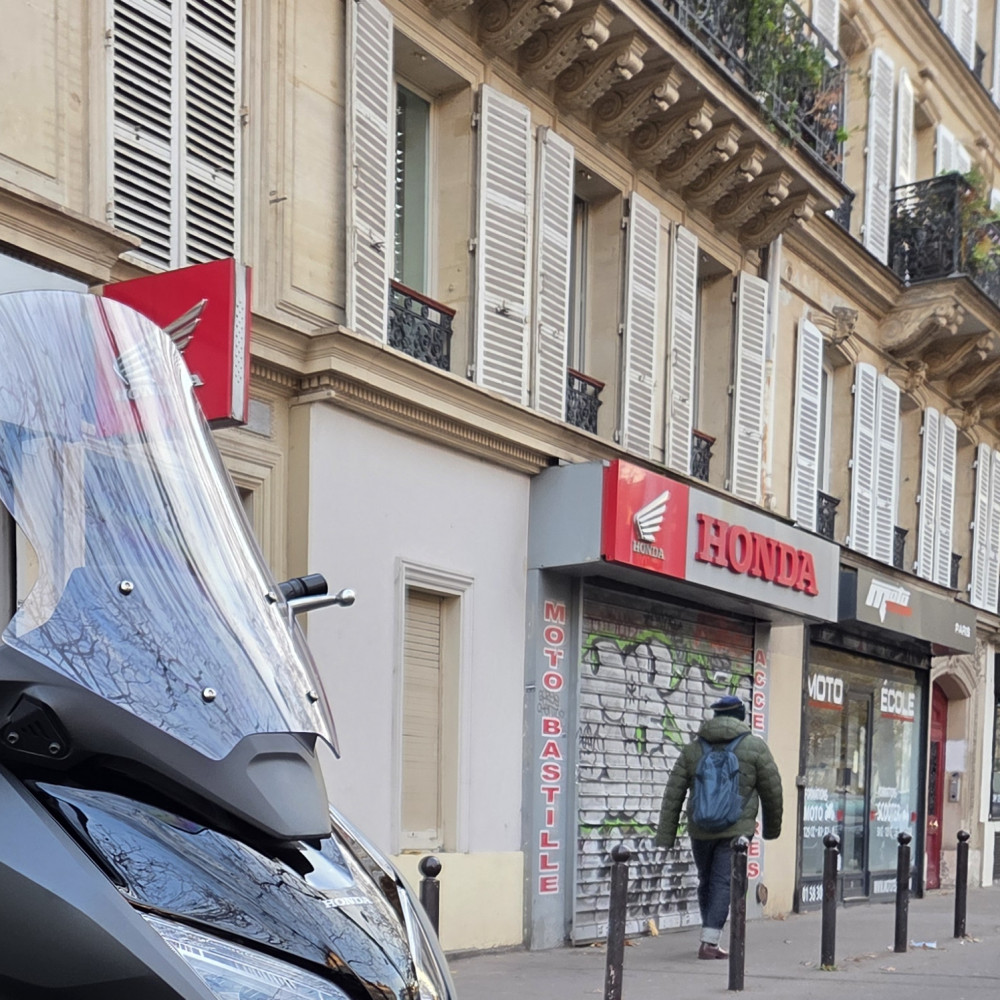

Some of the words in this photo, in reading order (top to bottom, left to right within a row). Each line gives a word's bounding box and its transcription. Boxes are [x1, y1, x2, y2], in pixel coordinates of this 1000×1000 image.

[632, 540, 665, 561] HONDA
[695, 513, 819, 596] HONDA
[543, 600, 566, 692] MOTO
[954, 622, 971, 638] PARIS
[880, 679, 916, 717] ÉCOLE
[746, 648, 768, 879] ACCEES
[539, 717, 562, 895] BASTILLE
[321, 896, 374, 909] HONDA
